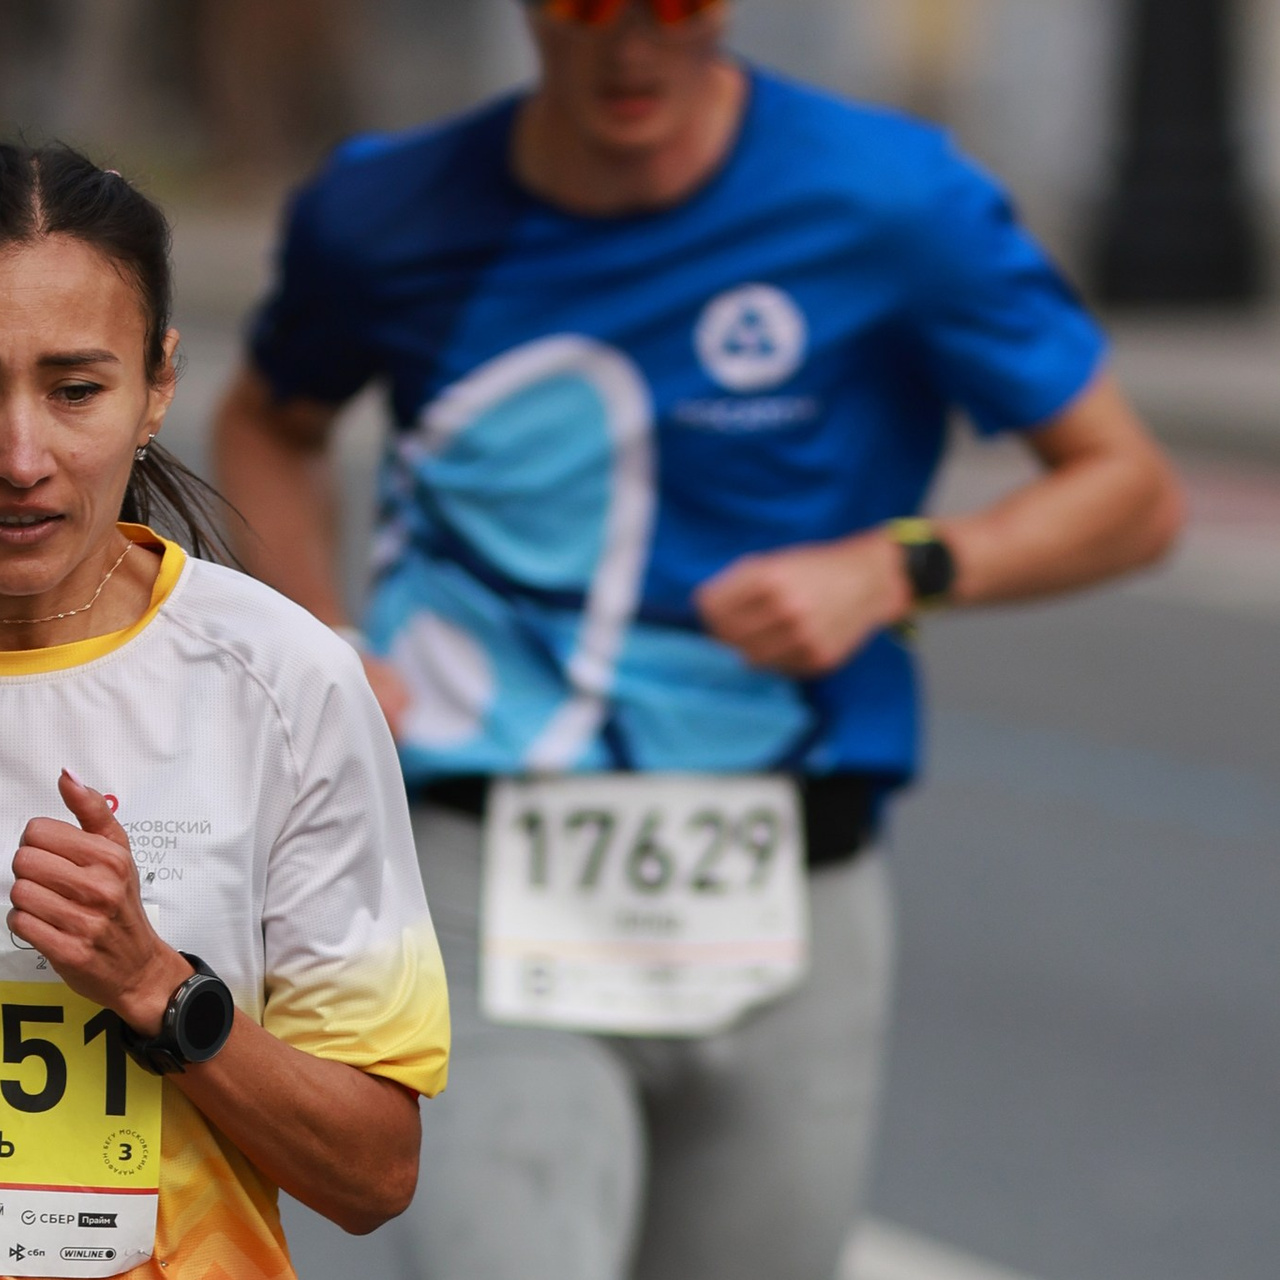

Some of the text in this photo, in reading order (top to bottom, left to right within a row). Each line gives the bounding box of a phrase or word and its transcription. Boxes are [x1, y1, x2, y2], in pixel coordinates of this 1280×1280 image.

[516, 808, 779, 893] 17629
[118, 1143, 133, 1161] 3
[39, 1213, 111, 1226] СБЕР Прайм
[27, 1248, 46, 1257] сбп
[64, 1249, 104, 1259] WINLINE
